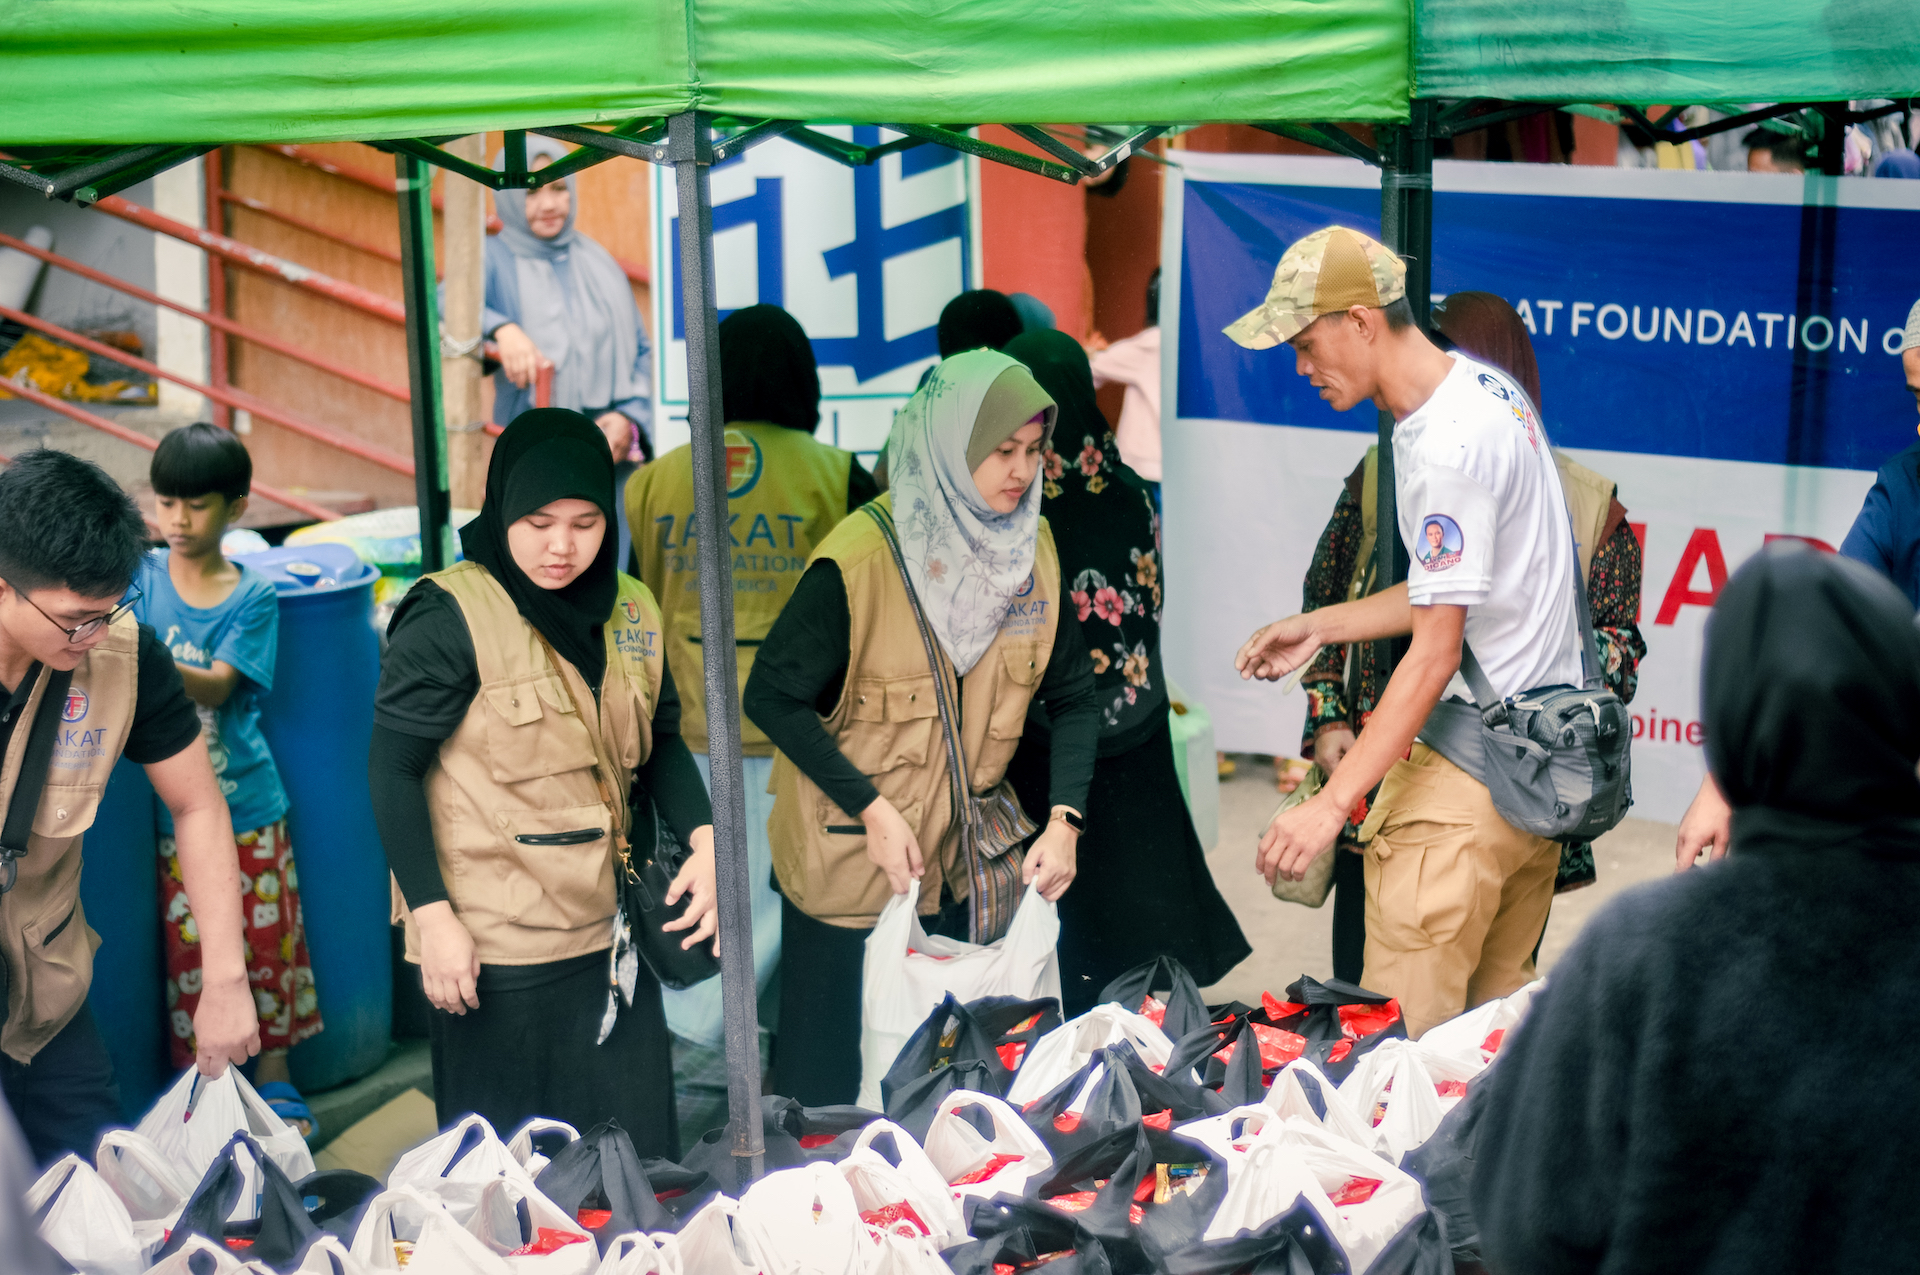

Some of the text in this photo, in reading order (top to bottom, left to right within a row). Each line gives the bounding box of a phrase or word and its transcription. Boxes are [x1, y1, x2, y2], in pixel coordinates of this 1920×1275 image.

[1570, 301, 1868, 354] FOUNDATION
[1882, 327, 1905, 356] o
[1006, 600, 1049, 618] AKAT
[613, 629, 657, 648] ZAKT
[53, 748, 106, 759] NDATION
